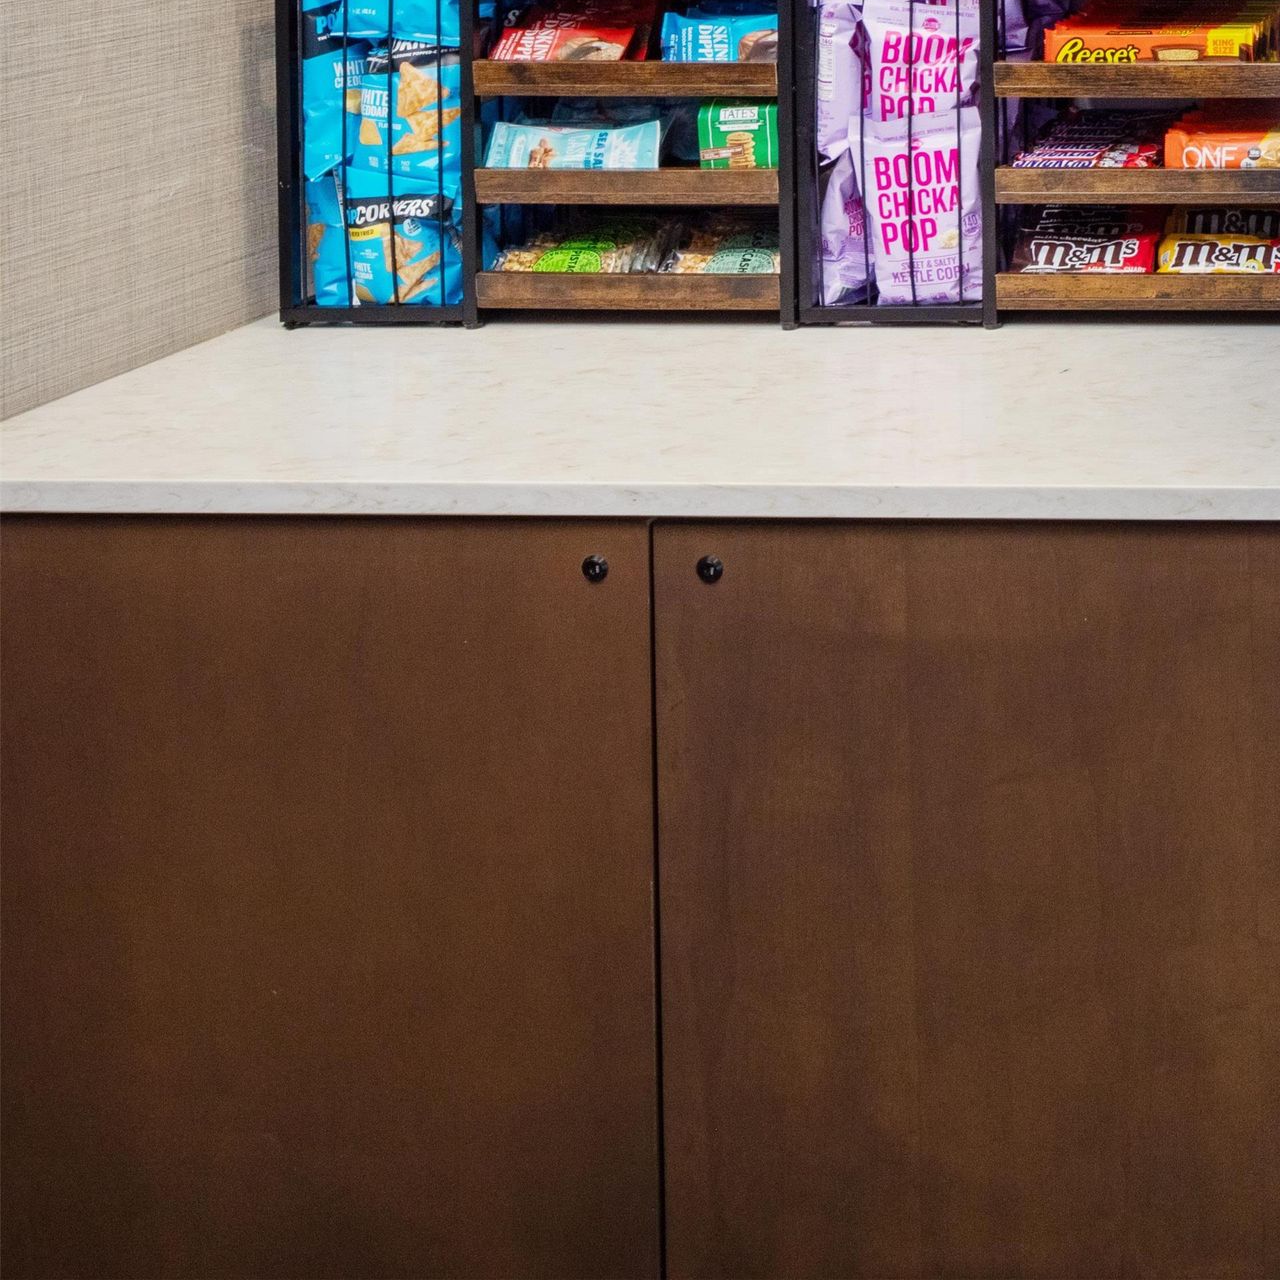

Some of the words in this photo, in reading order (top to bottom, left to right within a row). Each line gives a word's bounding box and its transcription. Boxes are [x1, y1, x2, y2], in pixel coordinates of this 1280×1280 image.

[881, 30, 974, 64] BOOM
[1056, 37, 1139, 63] Reese's
[1212, 39, 1234, 47] KING
[880, 65, 963, 94] CHICKA
[720, 108, 757, 119] TATE'S
[874, 148, 960, 191] BOOM
[1182, 145, 1239, 168] ONE
[878, 185, 960, 220] CHICKA
[880, 217, 937, 255] POP
[933, 257, 957, 268] SALTY
